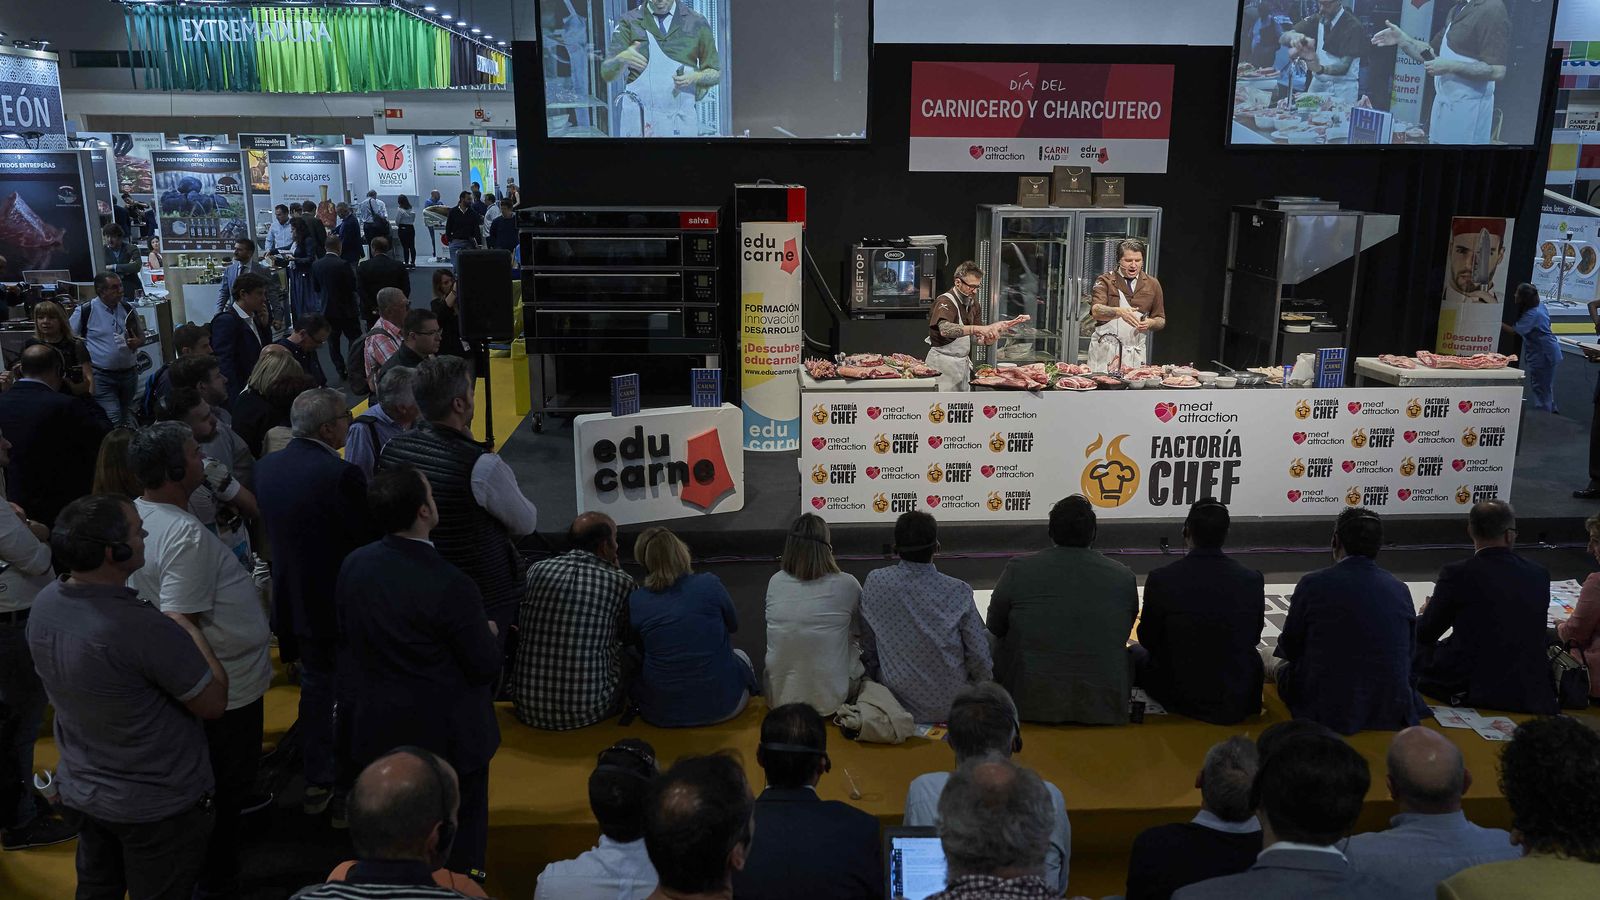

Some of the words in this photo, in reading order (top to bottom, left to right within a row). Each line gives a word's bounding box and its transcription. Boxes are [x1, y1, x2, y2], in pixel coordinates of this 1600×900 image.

[181, 19, 332, 43] EXTREMADURA
[1010, 72, 1034, 91] DÍA
[1042, 80, 1066, 91] DEL
[0, 88, 50, 128] EÓN
[921, 99, 1024, 119] CARNICERO
[1027, 100, 1038, 118] Y
[1043, 100, 1162, 120] CHARCUTERO
[290, 172, 331, 183] cascajares
[744, 232, 775, 248] edu
[744, 250, 794, 262] carne
[856, 254, 865, 302] CHEFTOP
[745, 303, 799, 313] FORMACIÓN
[745, 313, 799, 324] innovación
[745, 326, 799, 334] DESARROLLO
[745, 343, 799, 354] ¡Descubre
[1442, 343, 1492, 351] educarne!
[745, 354, 799, 365] educarne!
[1179, 401, 1213, 412] meat
[1424, 406, 1449, 418] CHEF
[831, 413, 857, 424] CHEF
[948, 412, 973, 423] CHEF
[1178, 412, 1238, 423] attraction
[1313, 407, 1338, 419] CHEF
[750, 420, 787, 438] edu
[592, 425, 670, 463] edu
[1008, 441, 1033, 452] CHEF
[1151, 429, 1242, 458] FACTORÍA
[1369, 436, 1394, 448] CHEF
[1480, 435, 1505, 447] CHEF
[893, 442, 919, 454] CHEF
[594, 459, 715, 492] carne
[1307, 465, 1333, 478] CHEF
[1418, 464, 1443, 476] CHEF
[830, 472, 857, 484] CHEF
[946, 471, 971, 482] CHEF
[1149, 460, 1241, 506] CHEF
[1363, 494, 1388, 505] CHEF
[1473, 492, 1498, 503] CHEF
[891, 501, 917, 512] CHEF
[1005, 499, 1031, 511] CHEF
